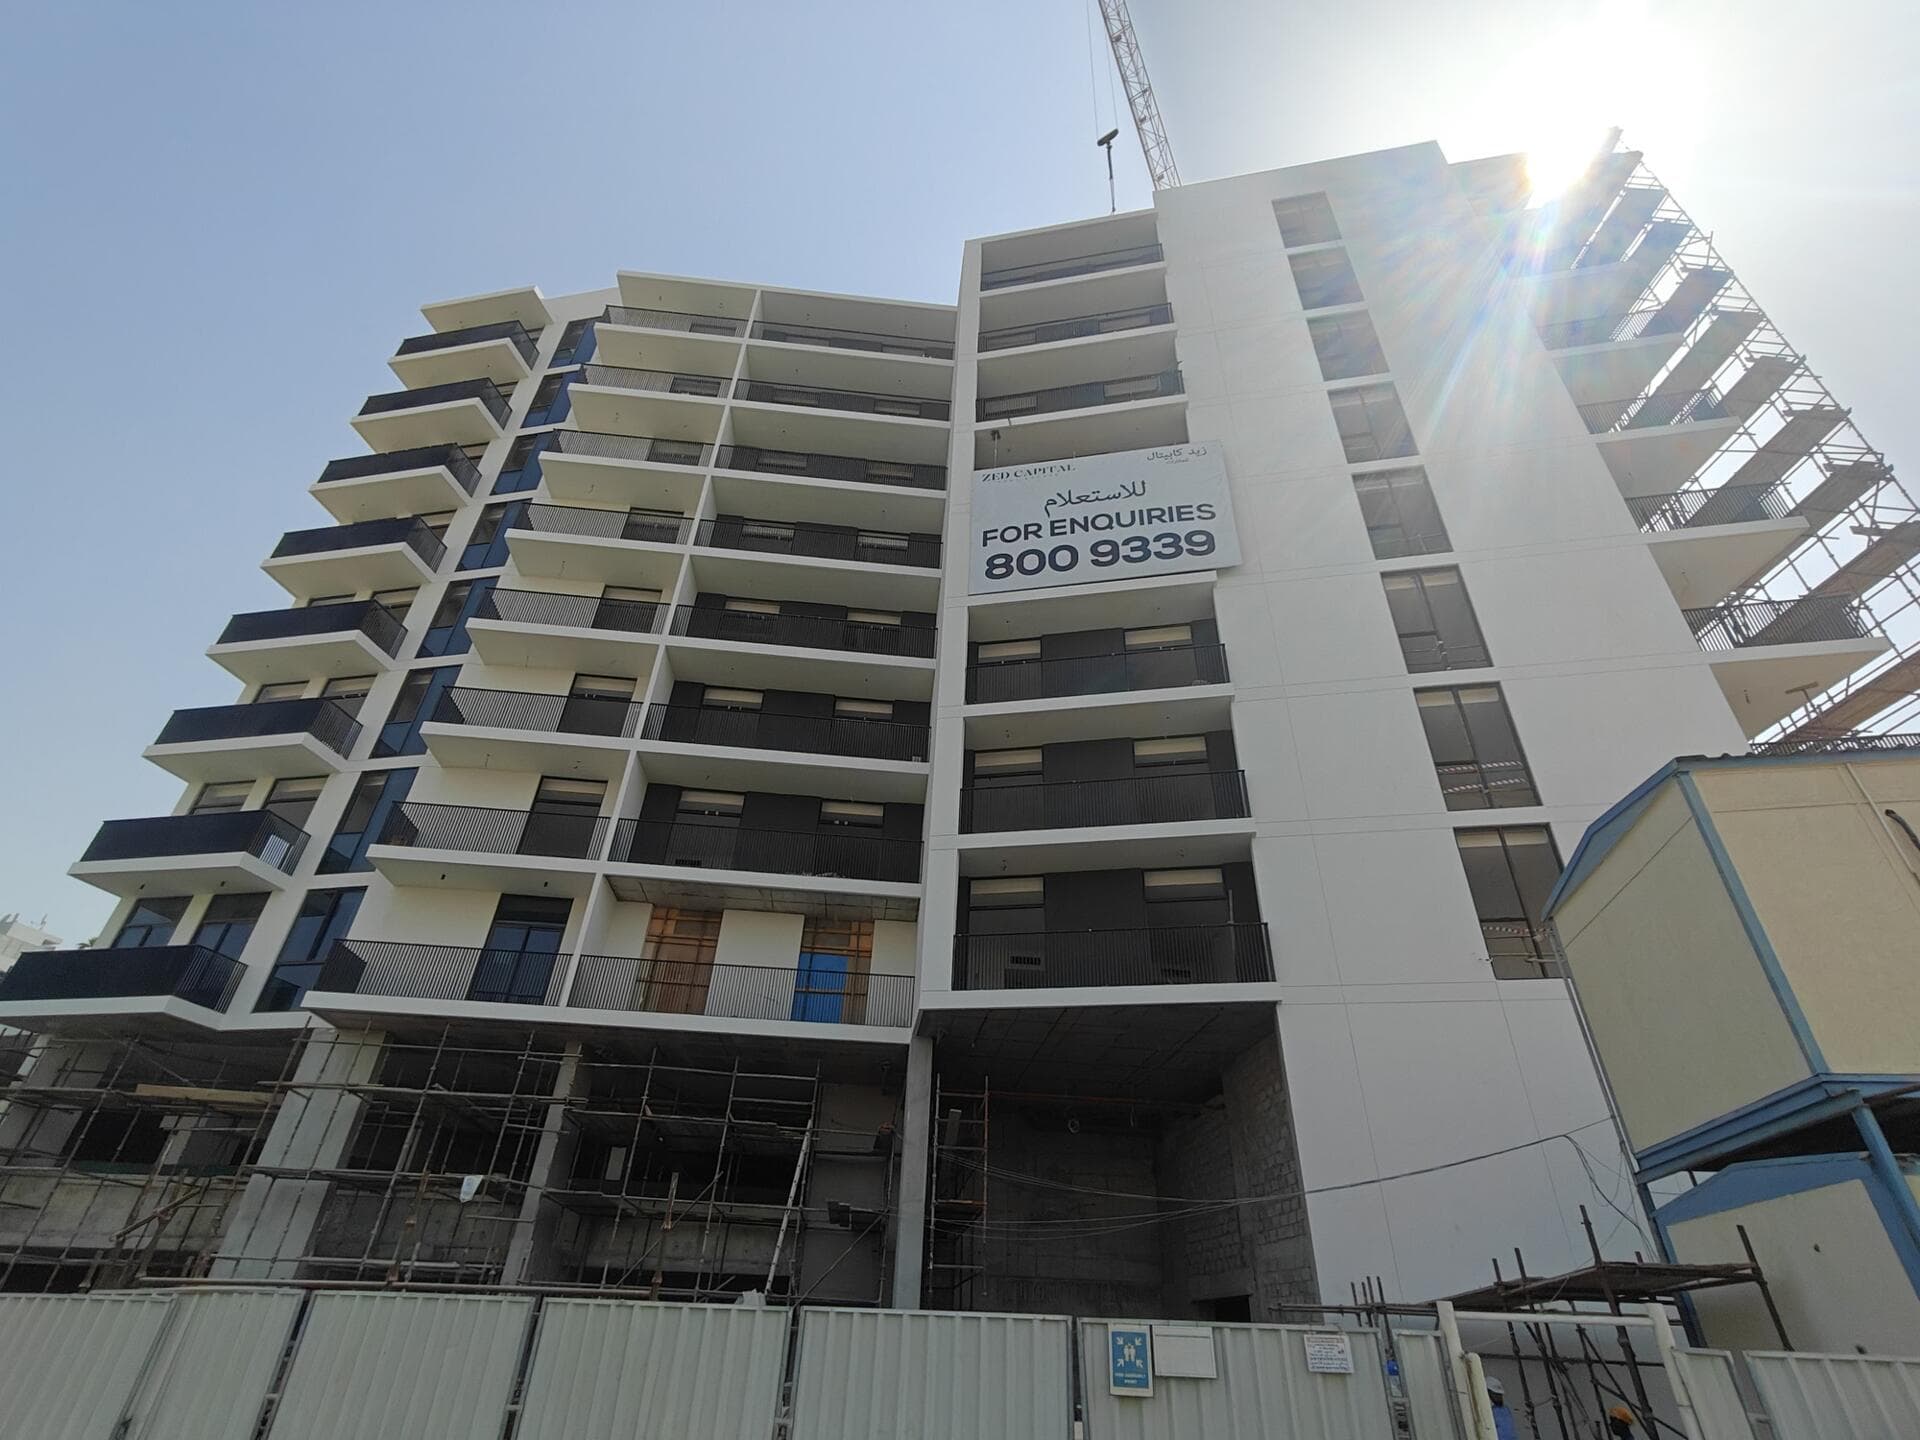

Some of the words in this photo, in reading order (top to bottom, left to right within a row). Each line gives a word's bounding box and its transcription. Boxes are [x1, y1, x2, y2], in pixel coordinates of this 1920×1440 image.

[1146, 447, 1184, 461] كابيتال
[982, 471, 1010, 482] ZED
[1014, 464, 1076, 478] CAPITAL
[1044, 481, 1146, 518] للاستعلام
[982, 522, 1043, 547] FOR
[1050, 503, 1217, 537] ENQUIRIES
[985, 545, 1079, 580] 800
[1090, 530, 1216, 568] 9339
